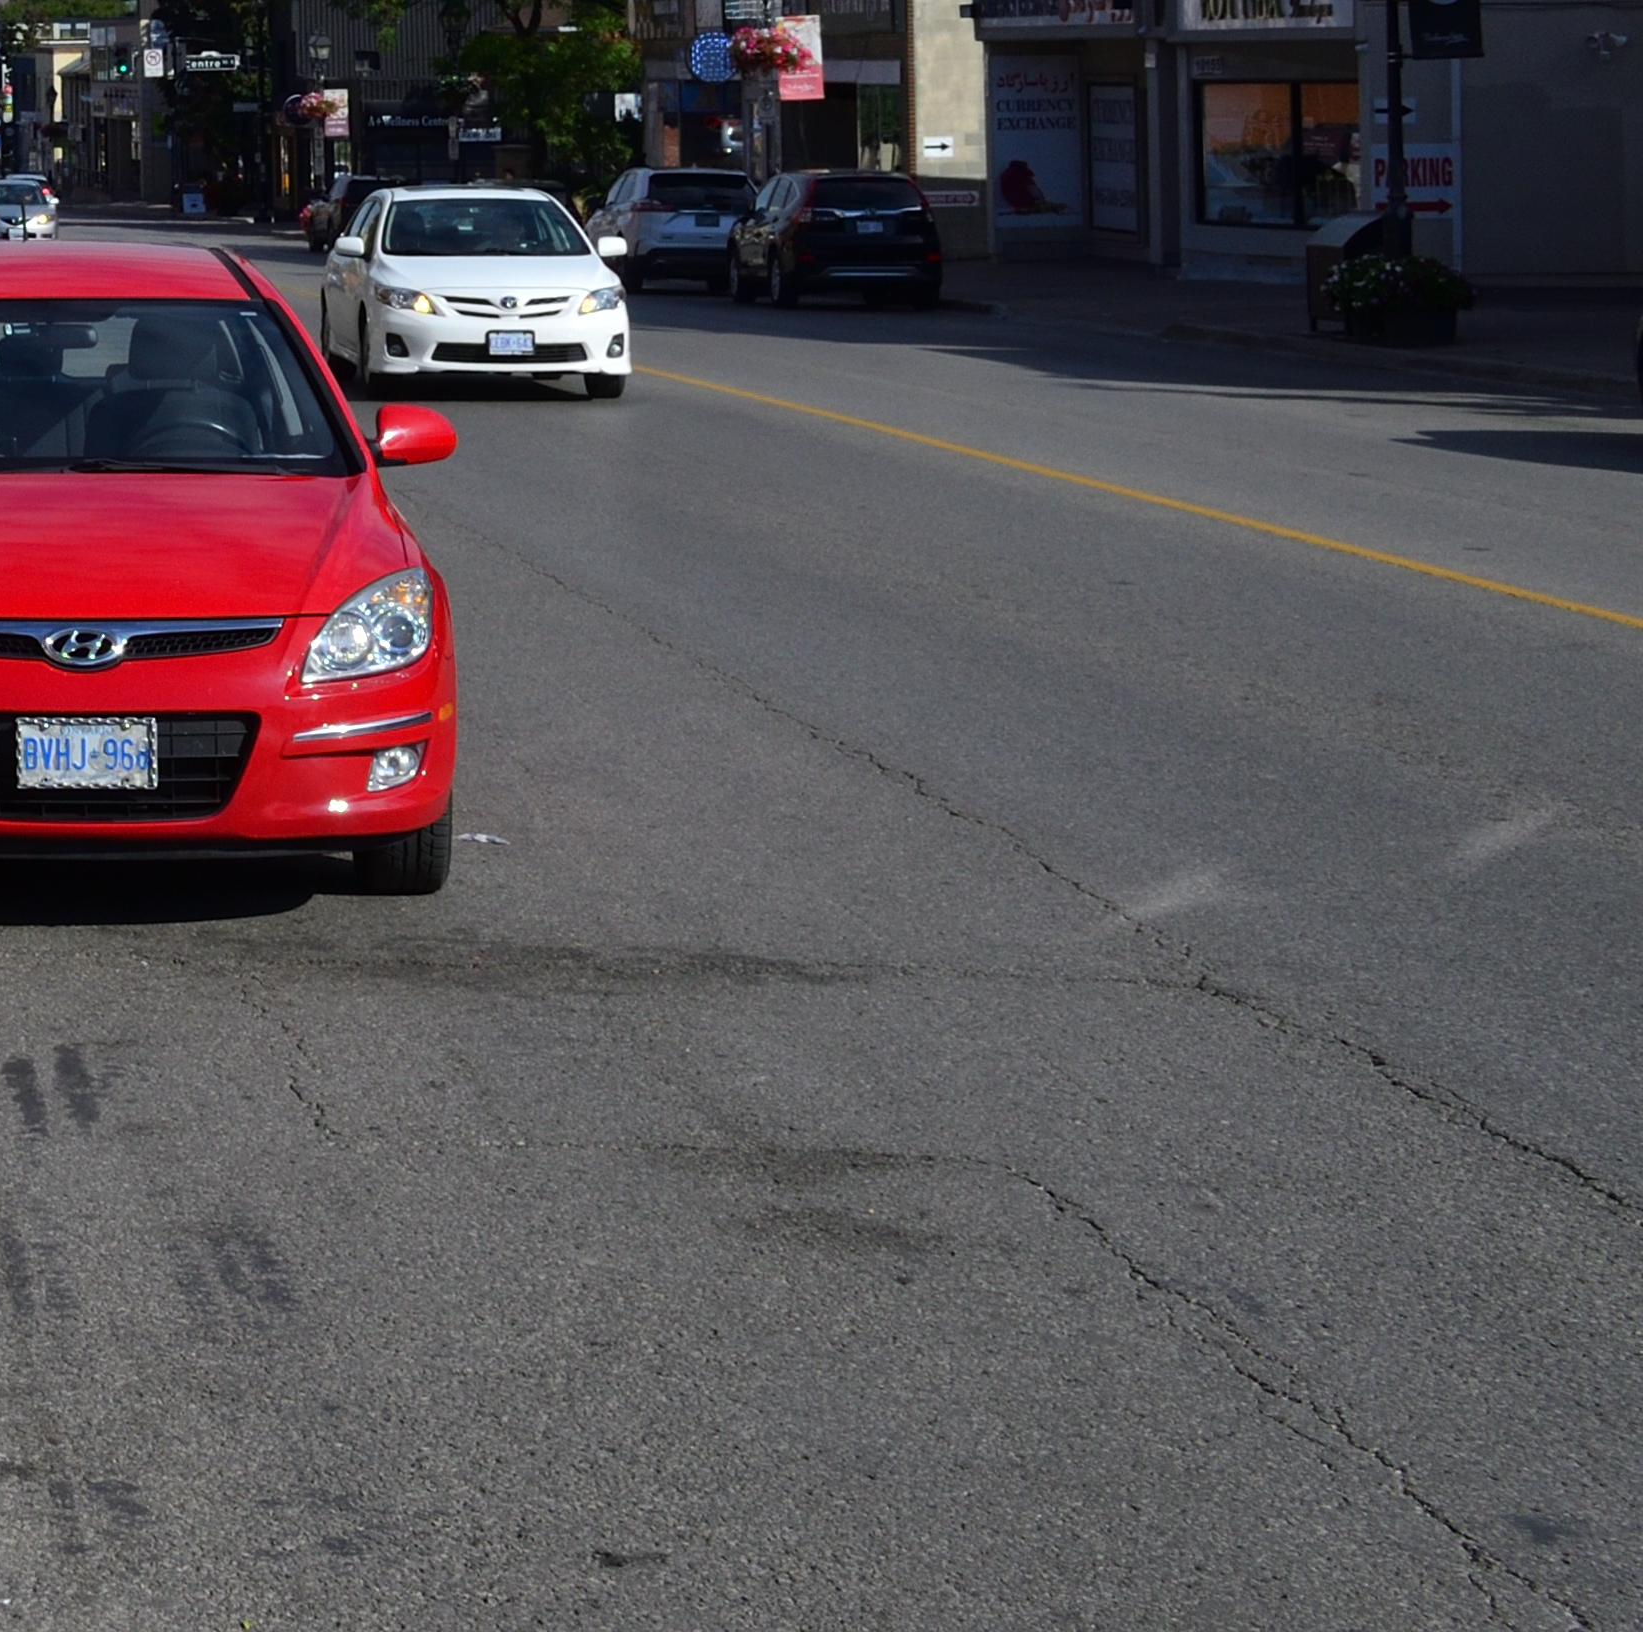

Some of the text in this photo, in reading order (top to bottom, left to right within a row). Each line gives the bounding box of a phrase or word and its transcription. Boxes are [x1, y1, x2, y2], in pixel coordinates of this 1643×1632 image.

[996, 99, 1075, 113] CURRENCY
[996, 117, 1076, 130] EXCHANGE
[1374, 156, 1453, 187] PRKING
[23, 737, 86, 771] BVHJ
